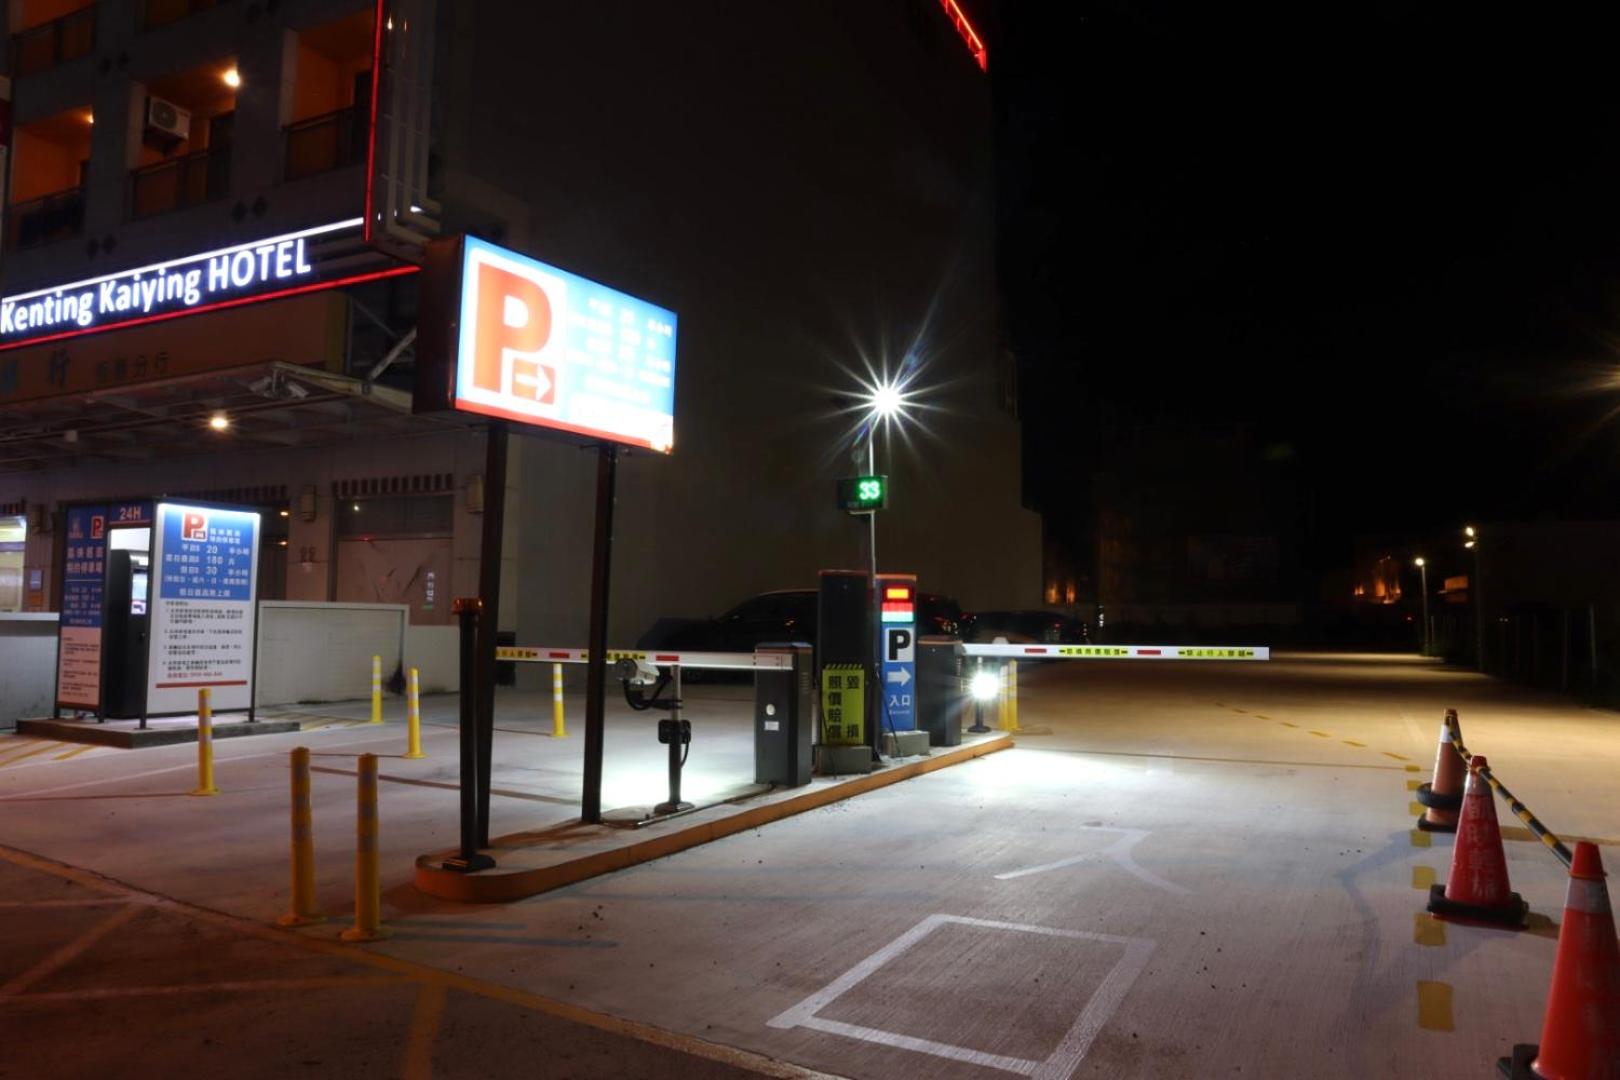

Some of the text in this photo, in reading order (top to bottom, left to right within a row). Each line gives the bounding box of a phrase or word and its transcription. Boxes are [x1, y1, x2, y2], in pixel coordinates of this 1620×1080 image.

[0, 238, 312, 334] Kenting Kaiying HOTEL
[473, 262, 552, 393] P
[859, 480, 880, 500] 33
[120, 506, 141, 520] 24H
[93, 518, 102, 537] P
[184, 513, 204, 538] P
[206, 544, 218, 554] 20
[207, 556, 223, 564] 180
[205, 566, 217, 575] 30
[888, 628, 911, 661] P
[888, 694, 911, 708] 入口
